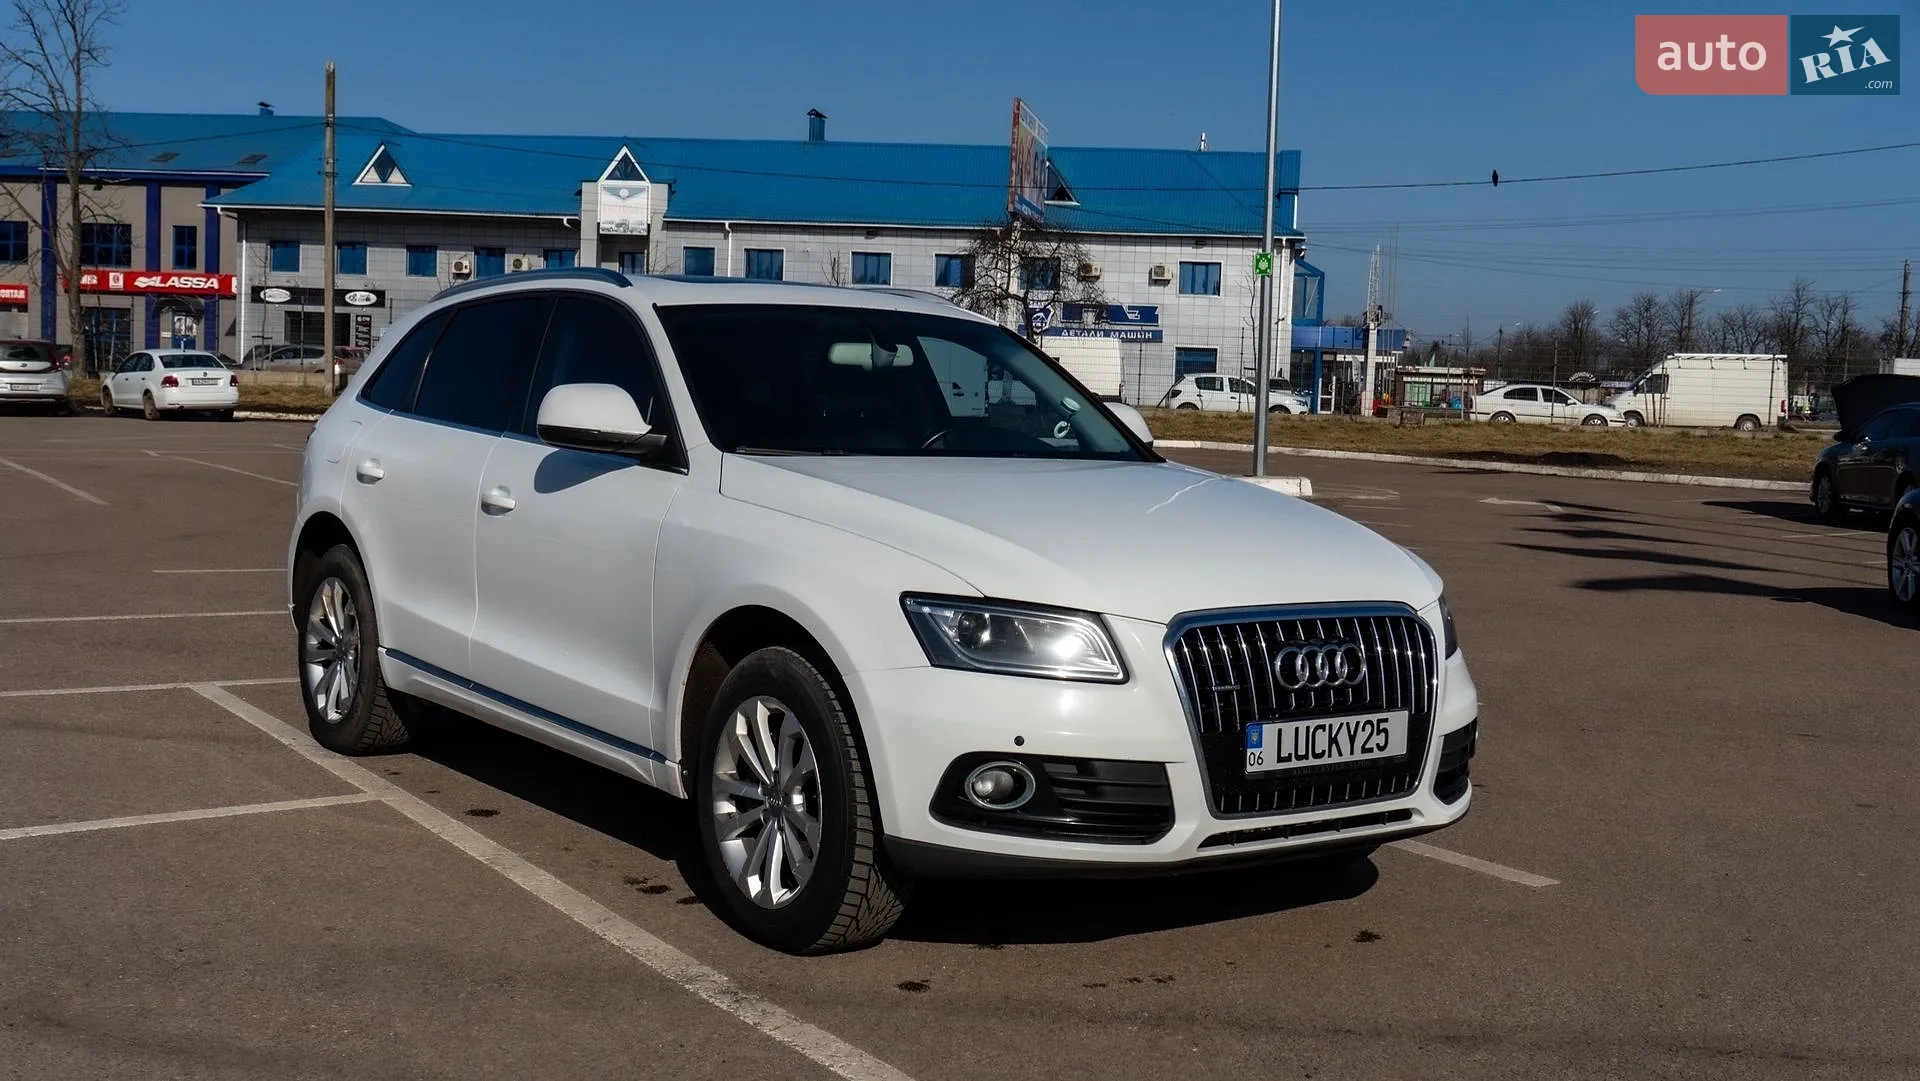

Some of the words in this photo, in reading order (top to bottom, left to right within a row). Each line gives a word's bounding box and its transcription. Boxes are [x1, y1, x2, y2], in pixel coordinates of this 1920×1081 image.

[155, 276, 219, 289] LASSA
[1061, 329, 1104, 338] ДЕТАЛИ
[1110, 331, 1153, 339] МАШИН
[1276, 718, 1389, 764] LUCKY25
[1248, 751, 1264, 767] 06
